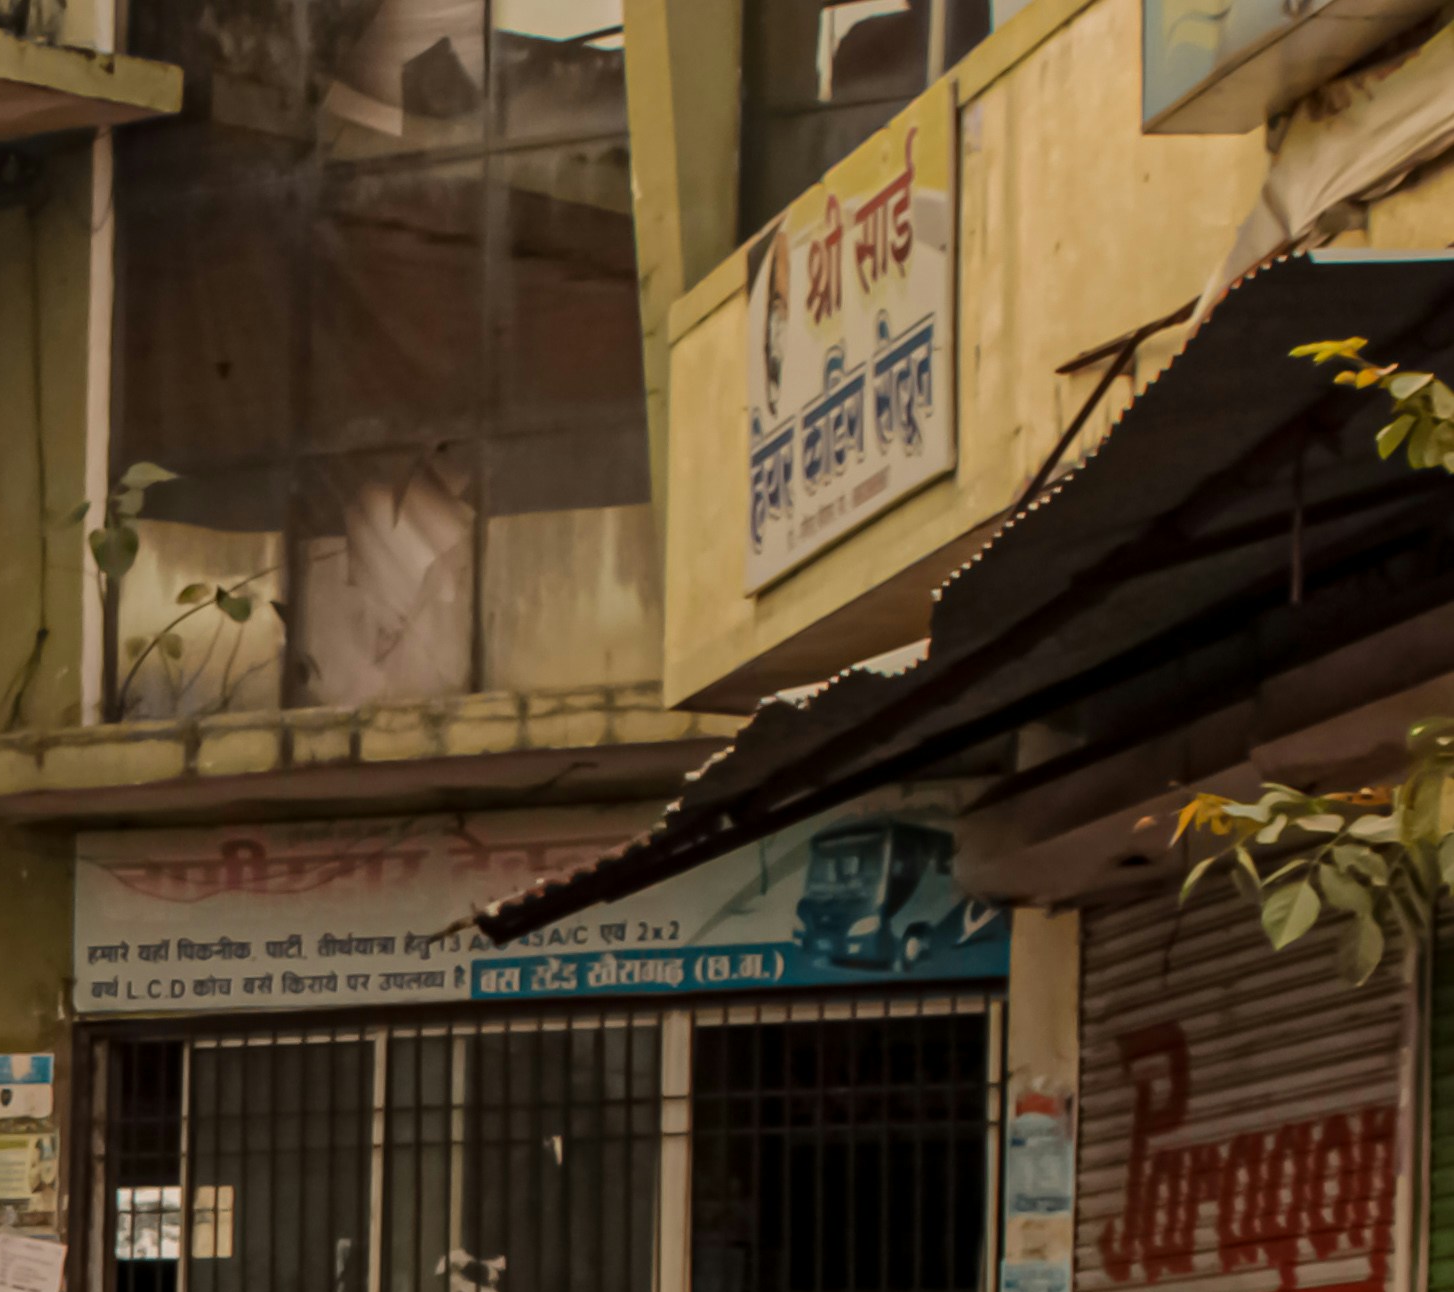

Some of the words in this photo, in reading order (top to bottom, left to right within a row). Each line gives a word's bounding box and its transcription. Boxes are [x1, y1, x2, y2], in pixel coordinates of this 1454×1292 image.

[806, 194, 843, 327] श्री
[346, 972, 371, 991] पर
[480, 966, 522, 993] बस
